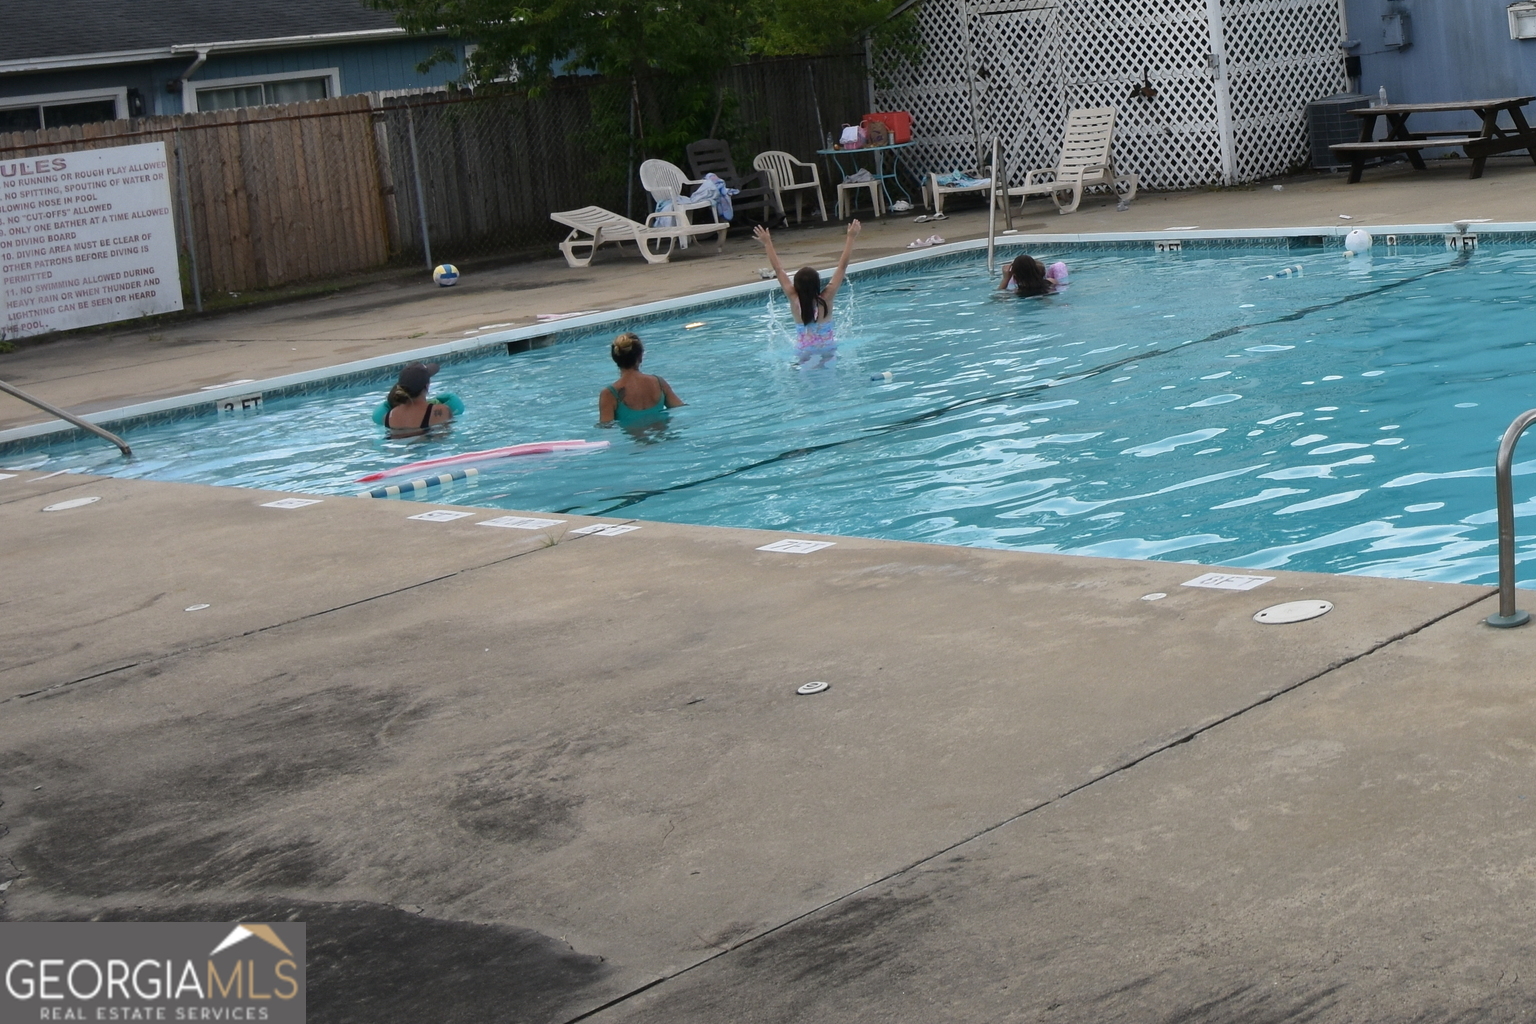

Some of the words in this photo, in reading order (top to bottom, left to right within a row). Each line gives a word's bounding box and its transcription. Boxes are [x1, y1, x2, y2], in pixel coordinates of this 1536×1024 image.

[3, 180, 16, 188] NO
[18, 175, 58, 186] RUNNING
[60, 173, 72, 181] OR
[74, 169, 104, 180] ROUGH
[106, 166, 127, 176] PLAY
[128, 161, 166, 172] ALLOWED
[4, 192, 17, 200] NO
[20, 186, 62, 198] SPITTING,
[64, 180, 107, 192] SPOUTING
[110, 178, 120, 186] OF
[122, 174, 151, 185] WATER
[152, 172, 164, 180] OR
[8, 216, 20, 224] NO
[22, 208, 70, 222] "CUT-OFFS"
[73, 203, 112, 215] ALLOWED
[38, 198, 62, 208] NOSE
[64, 197, 72, 205] IN
[76, 194, 98, 202] POOL
[9, 226, 32, 236] ONLY
[34, 224, 52, 232] ONE
[54, 219, 87, 230] BATHER
[90, 216, 100, 225] AT
[110, 212, 129, 222] TIME
[132, 208, 170, 219] ALLOWED
[0, 240, 12, 248] ON
[16, 236, 45, 247] DIVING
[48, 232, 76, 242] BOARD
[2, 253, 14, 261] 10.
[16, 248, 46, 259] DIVING
[49, 244, 72, 254] AREA
[74, 241, 97, 250] MUST
[100, 239, 110, 247] BE
[113, 235, 140, 245] CLEAR
[1462, 236, 1476, 250] FT
[2, 262, 32, 273] OTHER
[34, 257, 74, 268] PATRONS
[76, 251, 108, 262] BEFORE
[110, 246, 138, 257] DIVING
[141, 245, 149, 253] IS
[4, 271, 52, 285] PERMITTED
[20, 286, 32, 295] NO
[36, 279, 80, 292] SWIMMING
[82, 272, 122, 285] ALLOWED
[124, 266, 154, 278] DURING
[6, 298, 36, 309] HEAVY
[38, 294, 58, 304] RAIN
[61, 292, 73, 300] OR
[75, 287, 100, 298] WHEN
[102, 281, 142, 294] THUNDER
[144, 278, 160, 286] AND
[8, 306, 56, 321] LIGHTNING
[58, 303, 76, 313] CAN
[78, 301, 89, 310] BE
[91, 297, 112, 308] SEEN
[115, 295, 126, 303] OR
[128, 290, 156, 301] HEARD
[1, 325, 18, 334] THE
[21, 321, 48, 332] POOL.
[242, 396, 261, 410] FT
